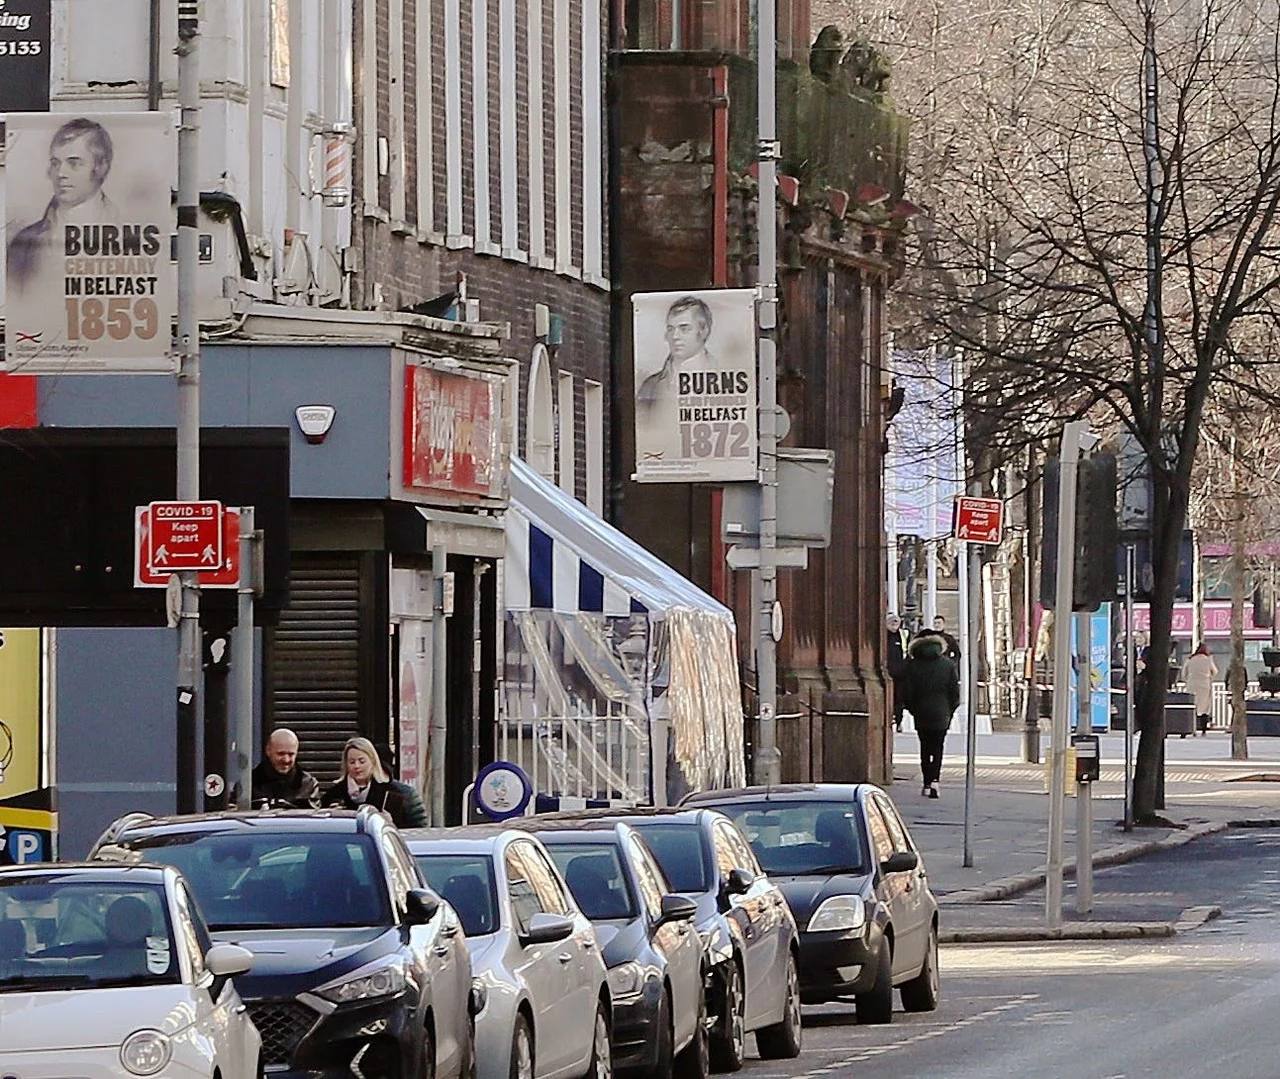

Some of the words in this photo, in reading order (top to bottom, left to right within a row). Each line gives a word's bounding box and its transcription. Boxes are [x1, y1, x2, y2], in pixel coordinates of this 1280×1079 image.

[64, 225, 161, 256] BURNS
[64, 258, 157, 274] CENTENARY
[65, 277, 81, 295] IN
[85, 277, 158, 295] BELFAST
[65, 297, 159, 341] 1859
[678, 371, 749, 395] BURNS
[680, 408, 692, 421] IN
[694, 407, 747, 421] BELFAST
[680, 422, 750, 458] 1872
[171, 522, 199, 532] Keep
[170, 534, 199, 543] apart
